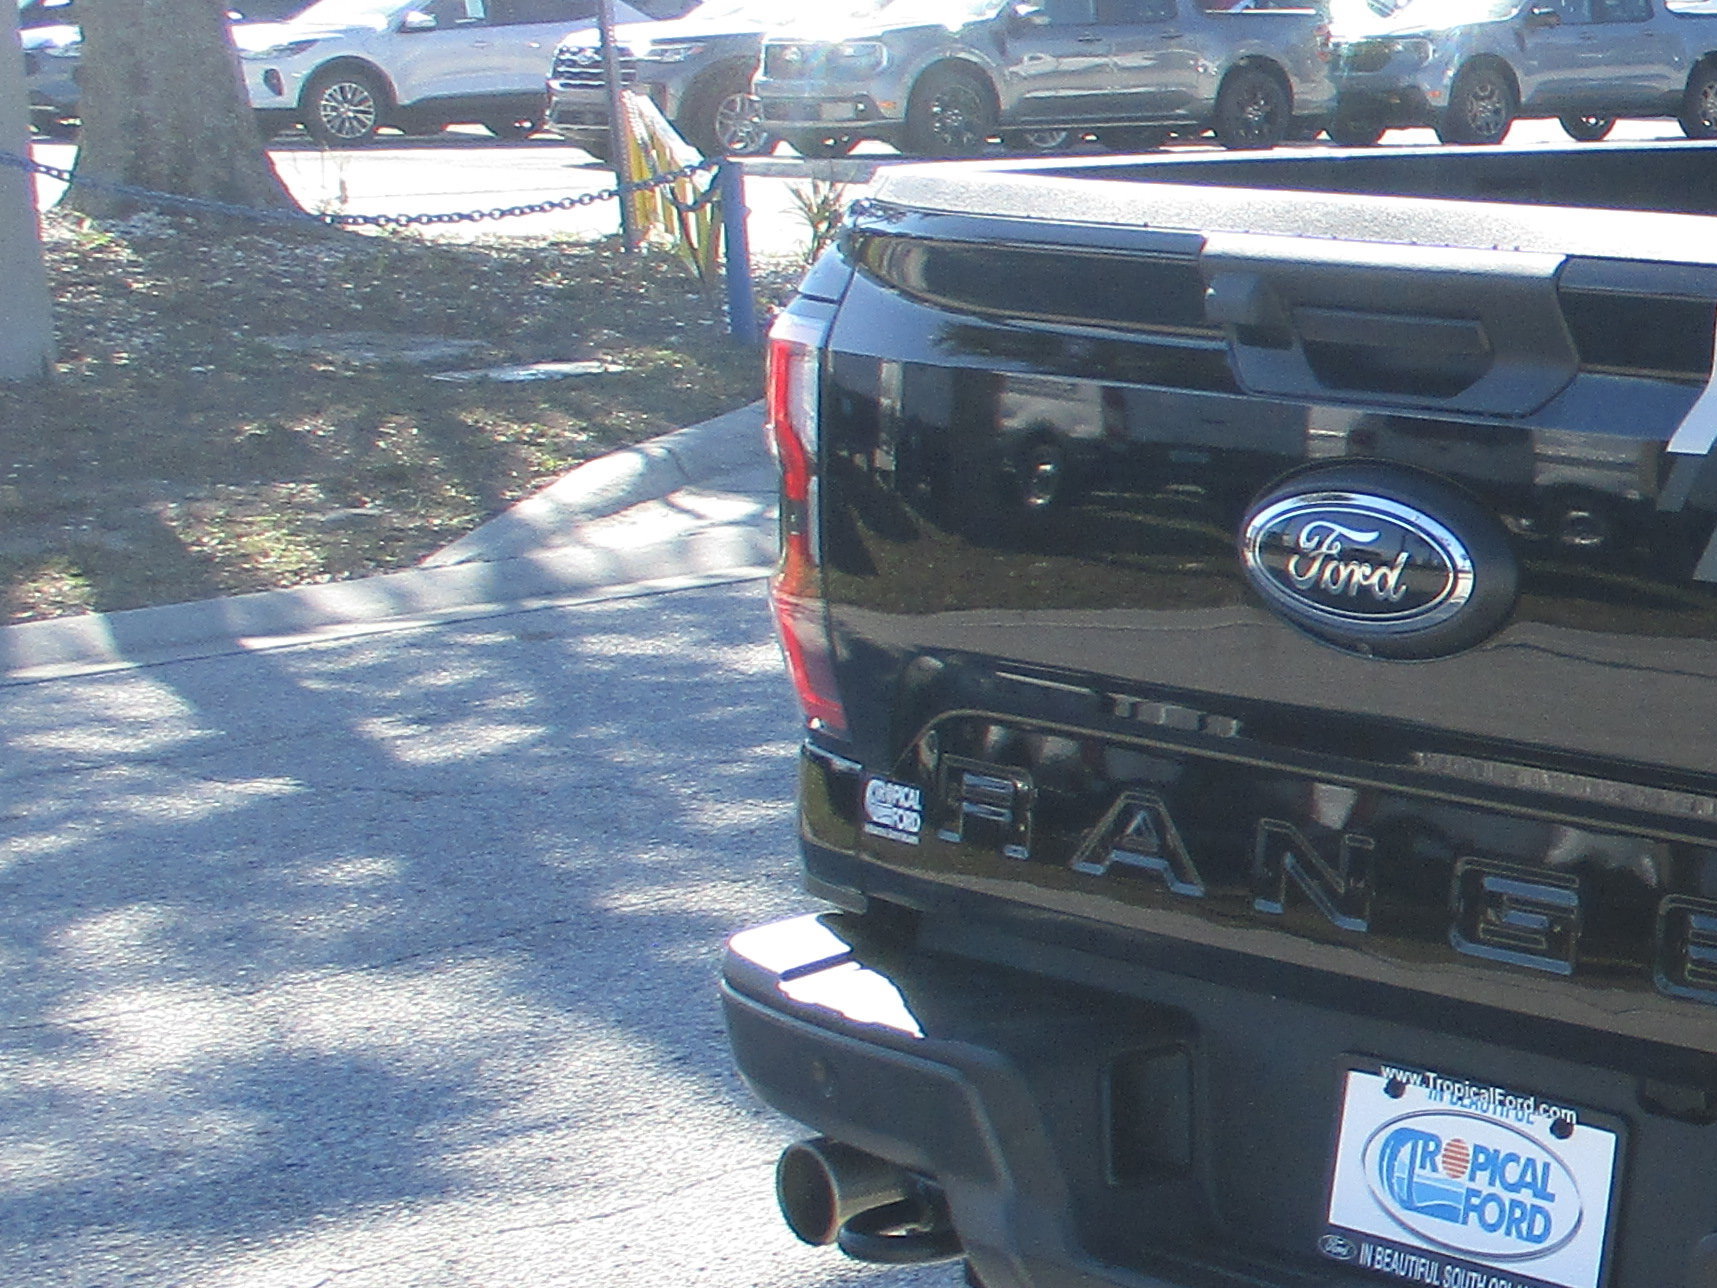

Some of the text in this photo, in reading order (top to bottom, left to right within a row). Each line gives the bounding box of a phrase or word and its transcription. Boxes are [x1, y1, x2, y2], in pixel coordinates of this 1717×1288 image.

[1287, 519, 1409, 603] Ford
[1380, 1065, 1577, 1124] www.TropicalFord.com
[1461, 1186, 1553, 1244] FORD
[1359, 1242, 1374, 1267] IN
[1374, 1247, 1441, 1287] BEAUTIFUL
